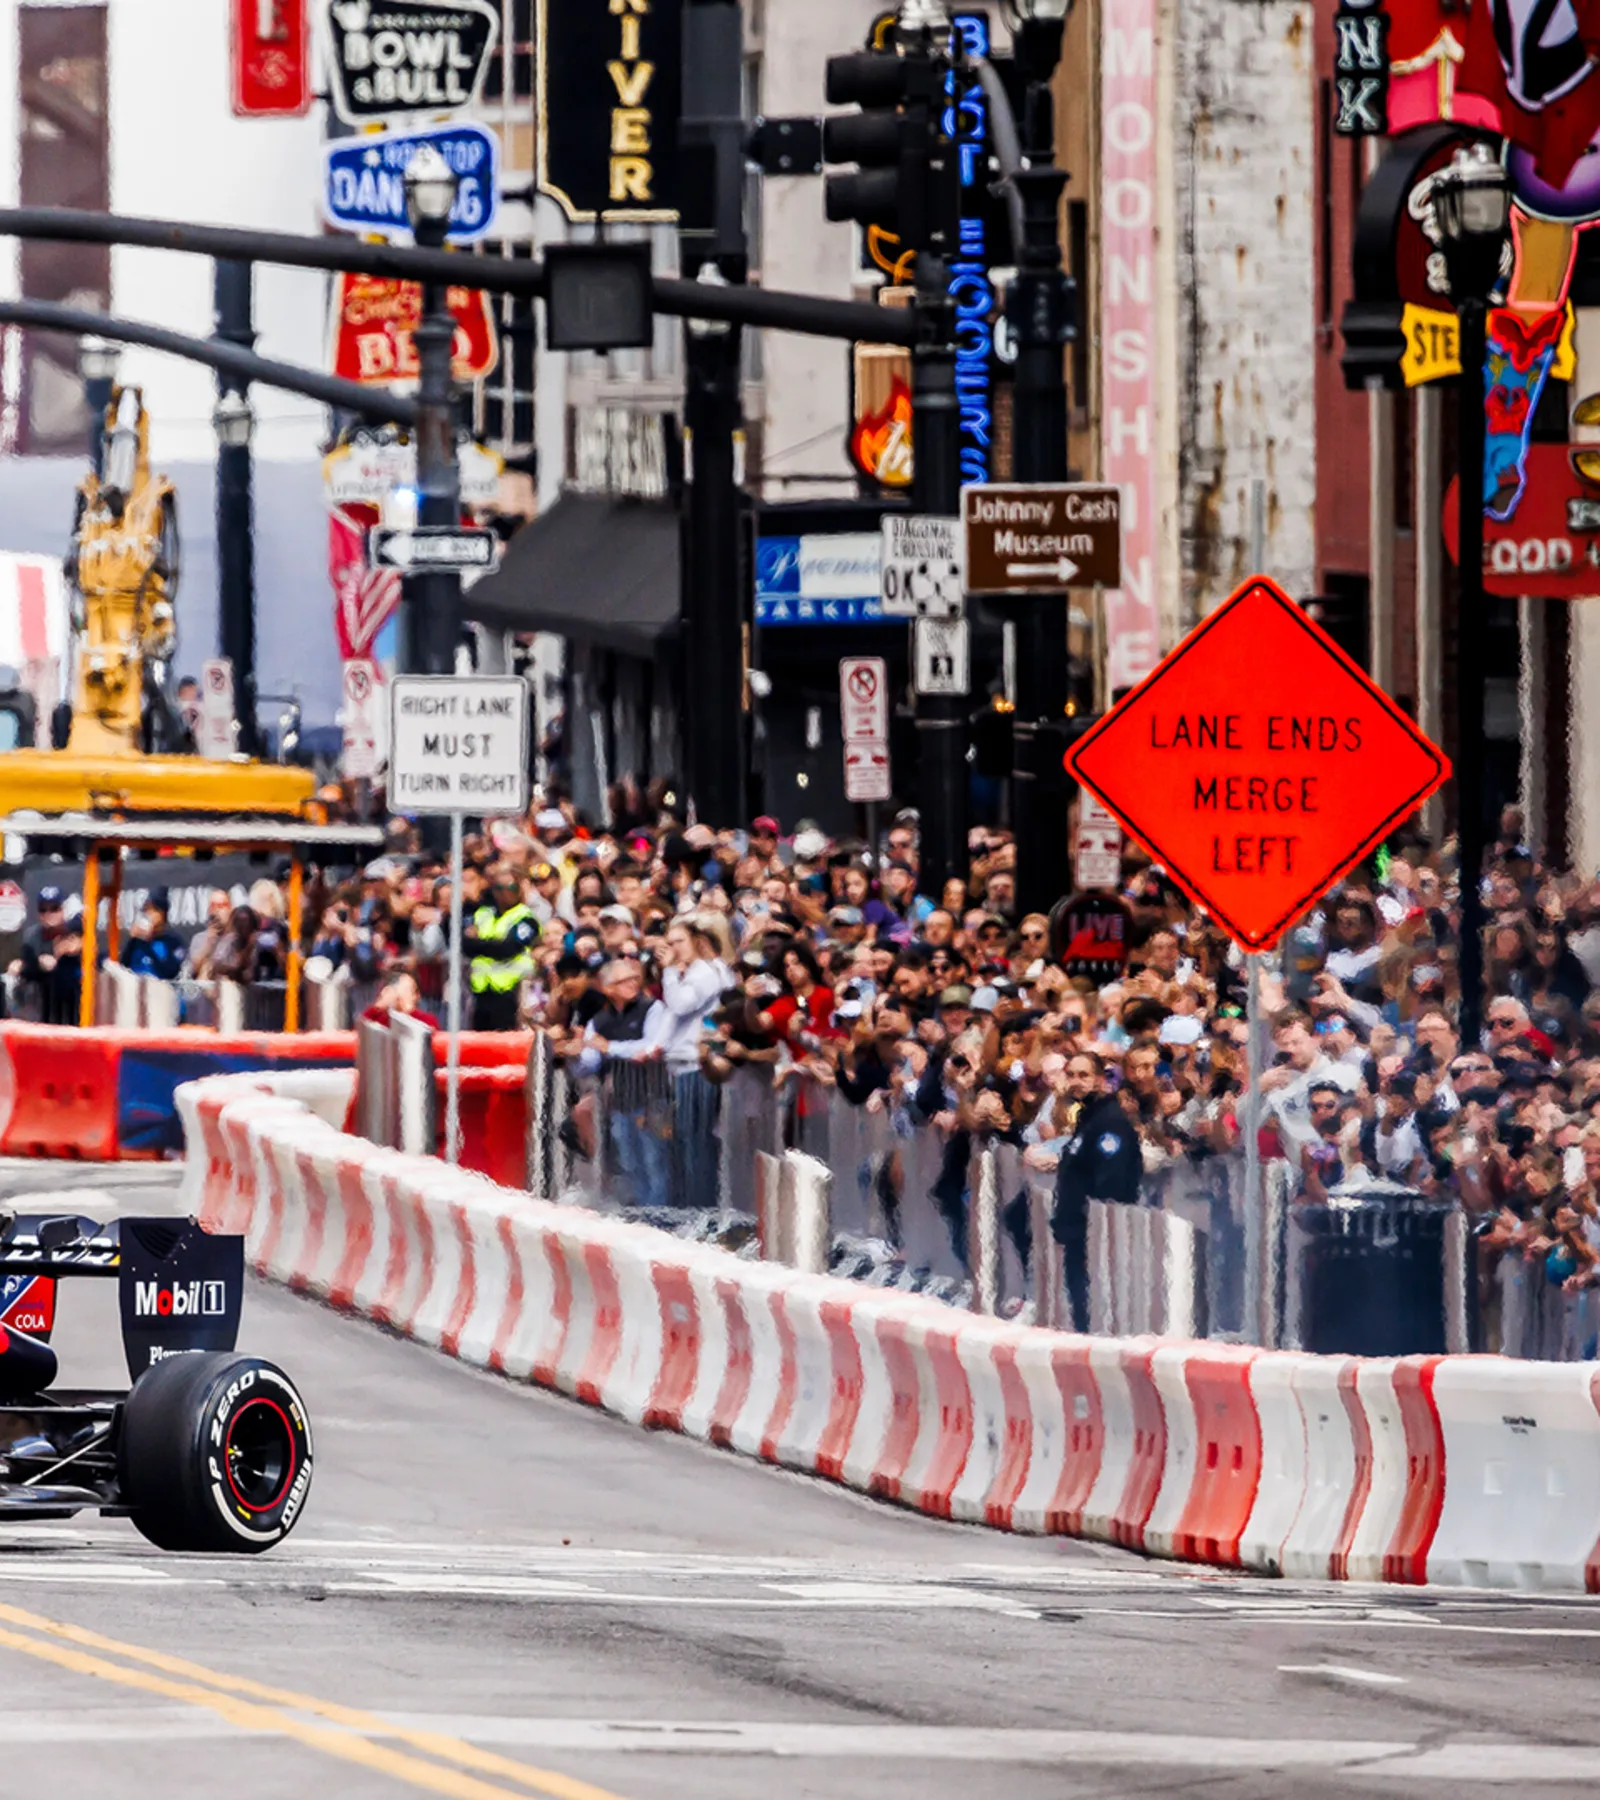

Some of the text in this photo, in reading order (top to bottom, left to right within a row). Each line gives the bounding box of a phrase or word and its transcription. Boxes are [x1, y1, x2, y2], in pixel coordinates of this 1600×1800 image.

[343, 30, 474, 71] BOWL
[1337, 0, 1383, 132] NK
[331, 166, 483, 226] DANG
[968, 493, 1120, 528] Johnny Cash
[993, 529, 1094, 556] Museum
[1483, 537, 1572, 574] OOD
[400, 695, 515, 717] RIGHT LANE
[422, 732, 492, 758] MUST
[1150, 714, 1363, 752] LANE ENDS
[398, 772, 516, 795] TURN RIGHT
[1193, 776, 1319, 813] MERGE
[1212, 835, 1299, 874] LEFT
[135, 1280, 200, 1316] Mobil
[14, 1313, 46, 1329] COLA
[211, 1368, 255, 1448] ZERO
